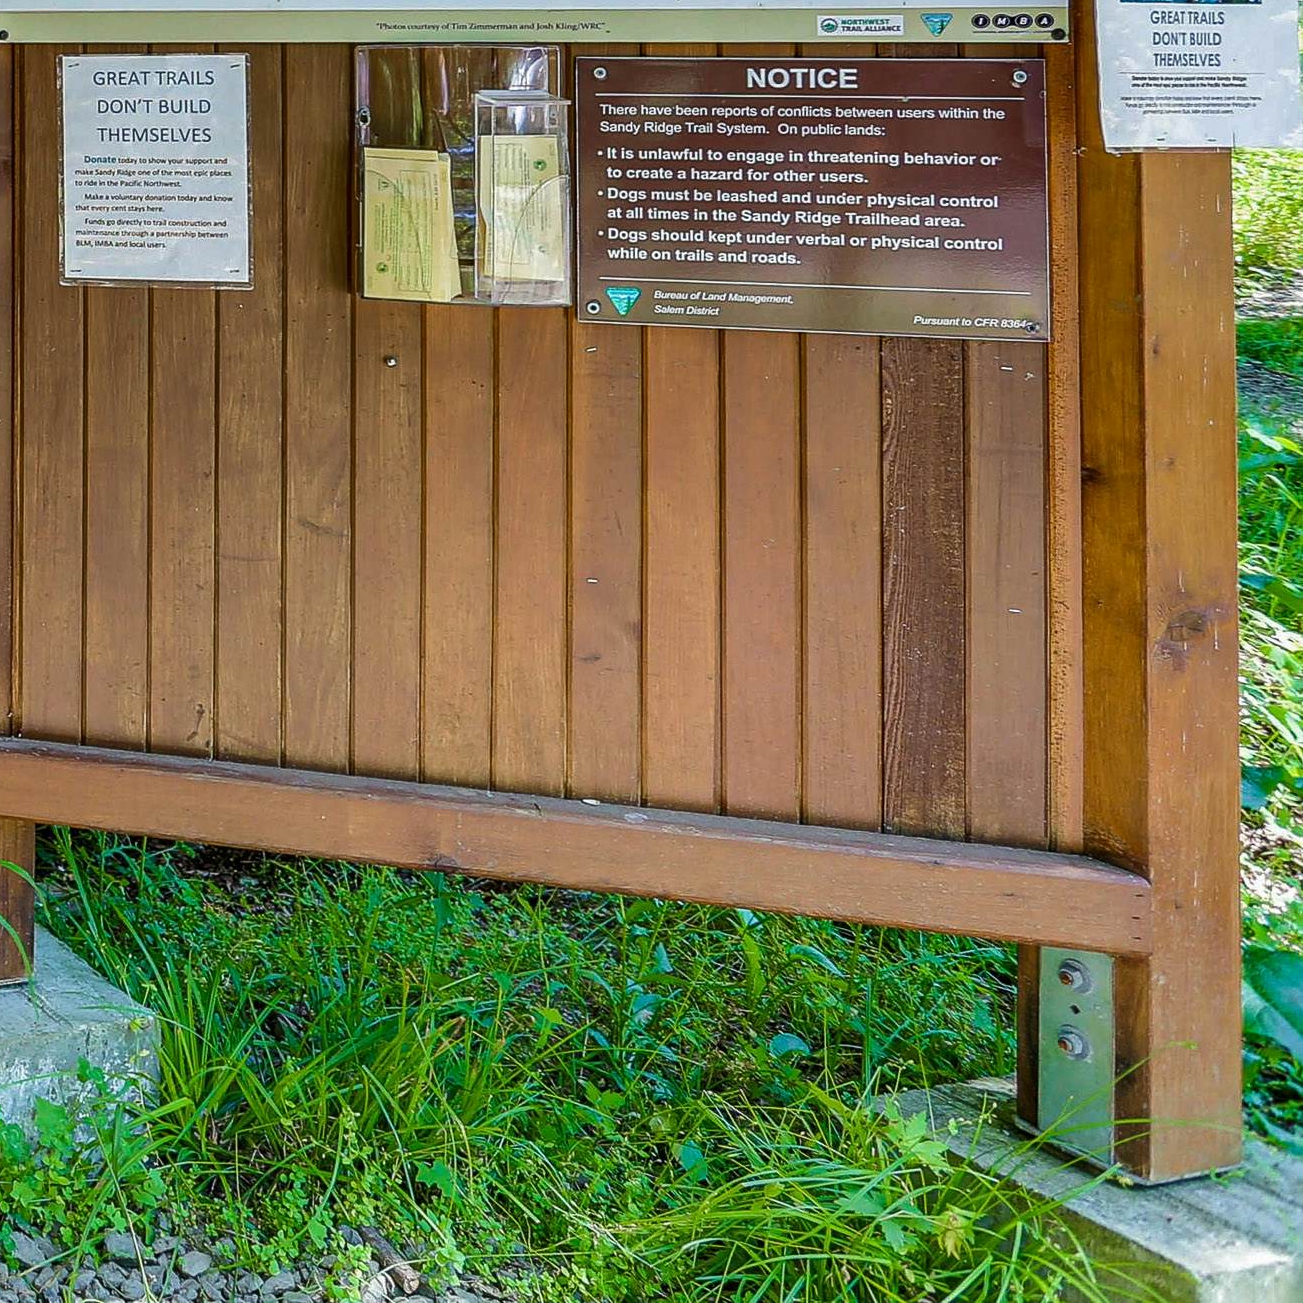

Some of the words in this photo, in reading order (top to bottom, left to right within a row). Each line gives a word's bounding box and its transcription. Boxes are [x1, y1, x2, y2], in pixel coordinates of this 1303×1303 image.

[1149, 9, 1186, 24] GREAT
[1187, 11, 1225, 25] TRAILS
[1152, 52, 1221, 67] THEMSELVES
[92, 71, 151, 86] GREAT
[153, 70, 214, 88] TRAILS
[746, 67, 858, 88] NOTICE
[599, 103, 637, 115] There
[640, 104, 675, 116] have
[675, 104, 708, 116] been
[711, 105, 758, 118] reports
[760, 105, 775, 117] of
[777, 105, 832, 117] conflicts
[835, 106, 893, 118] between
[896, 109, 935, 119] users
[937, 107, 979, 119] within
[982, 107, 1005, 119] the
[96, 126, 212, 143] THEMSELVES
